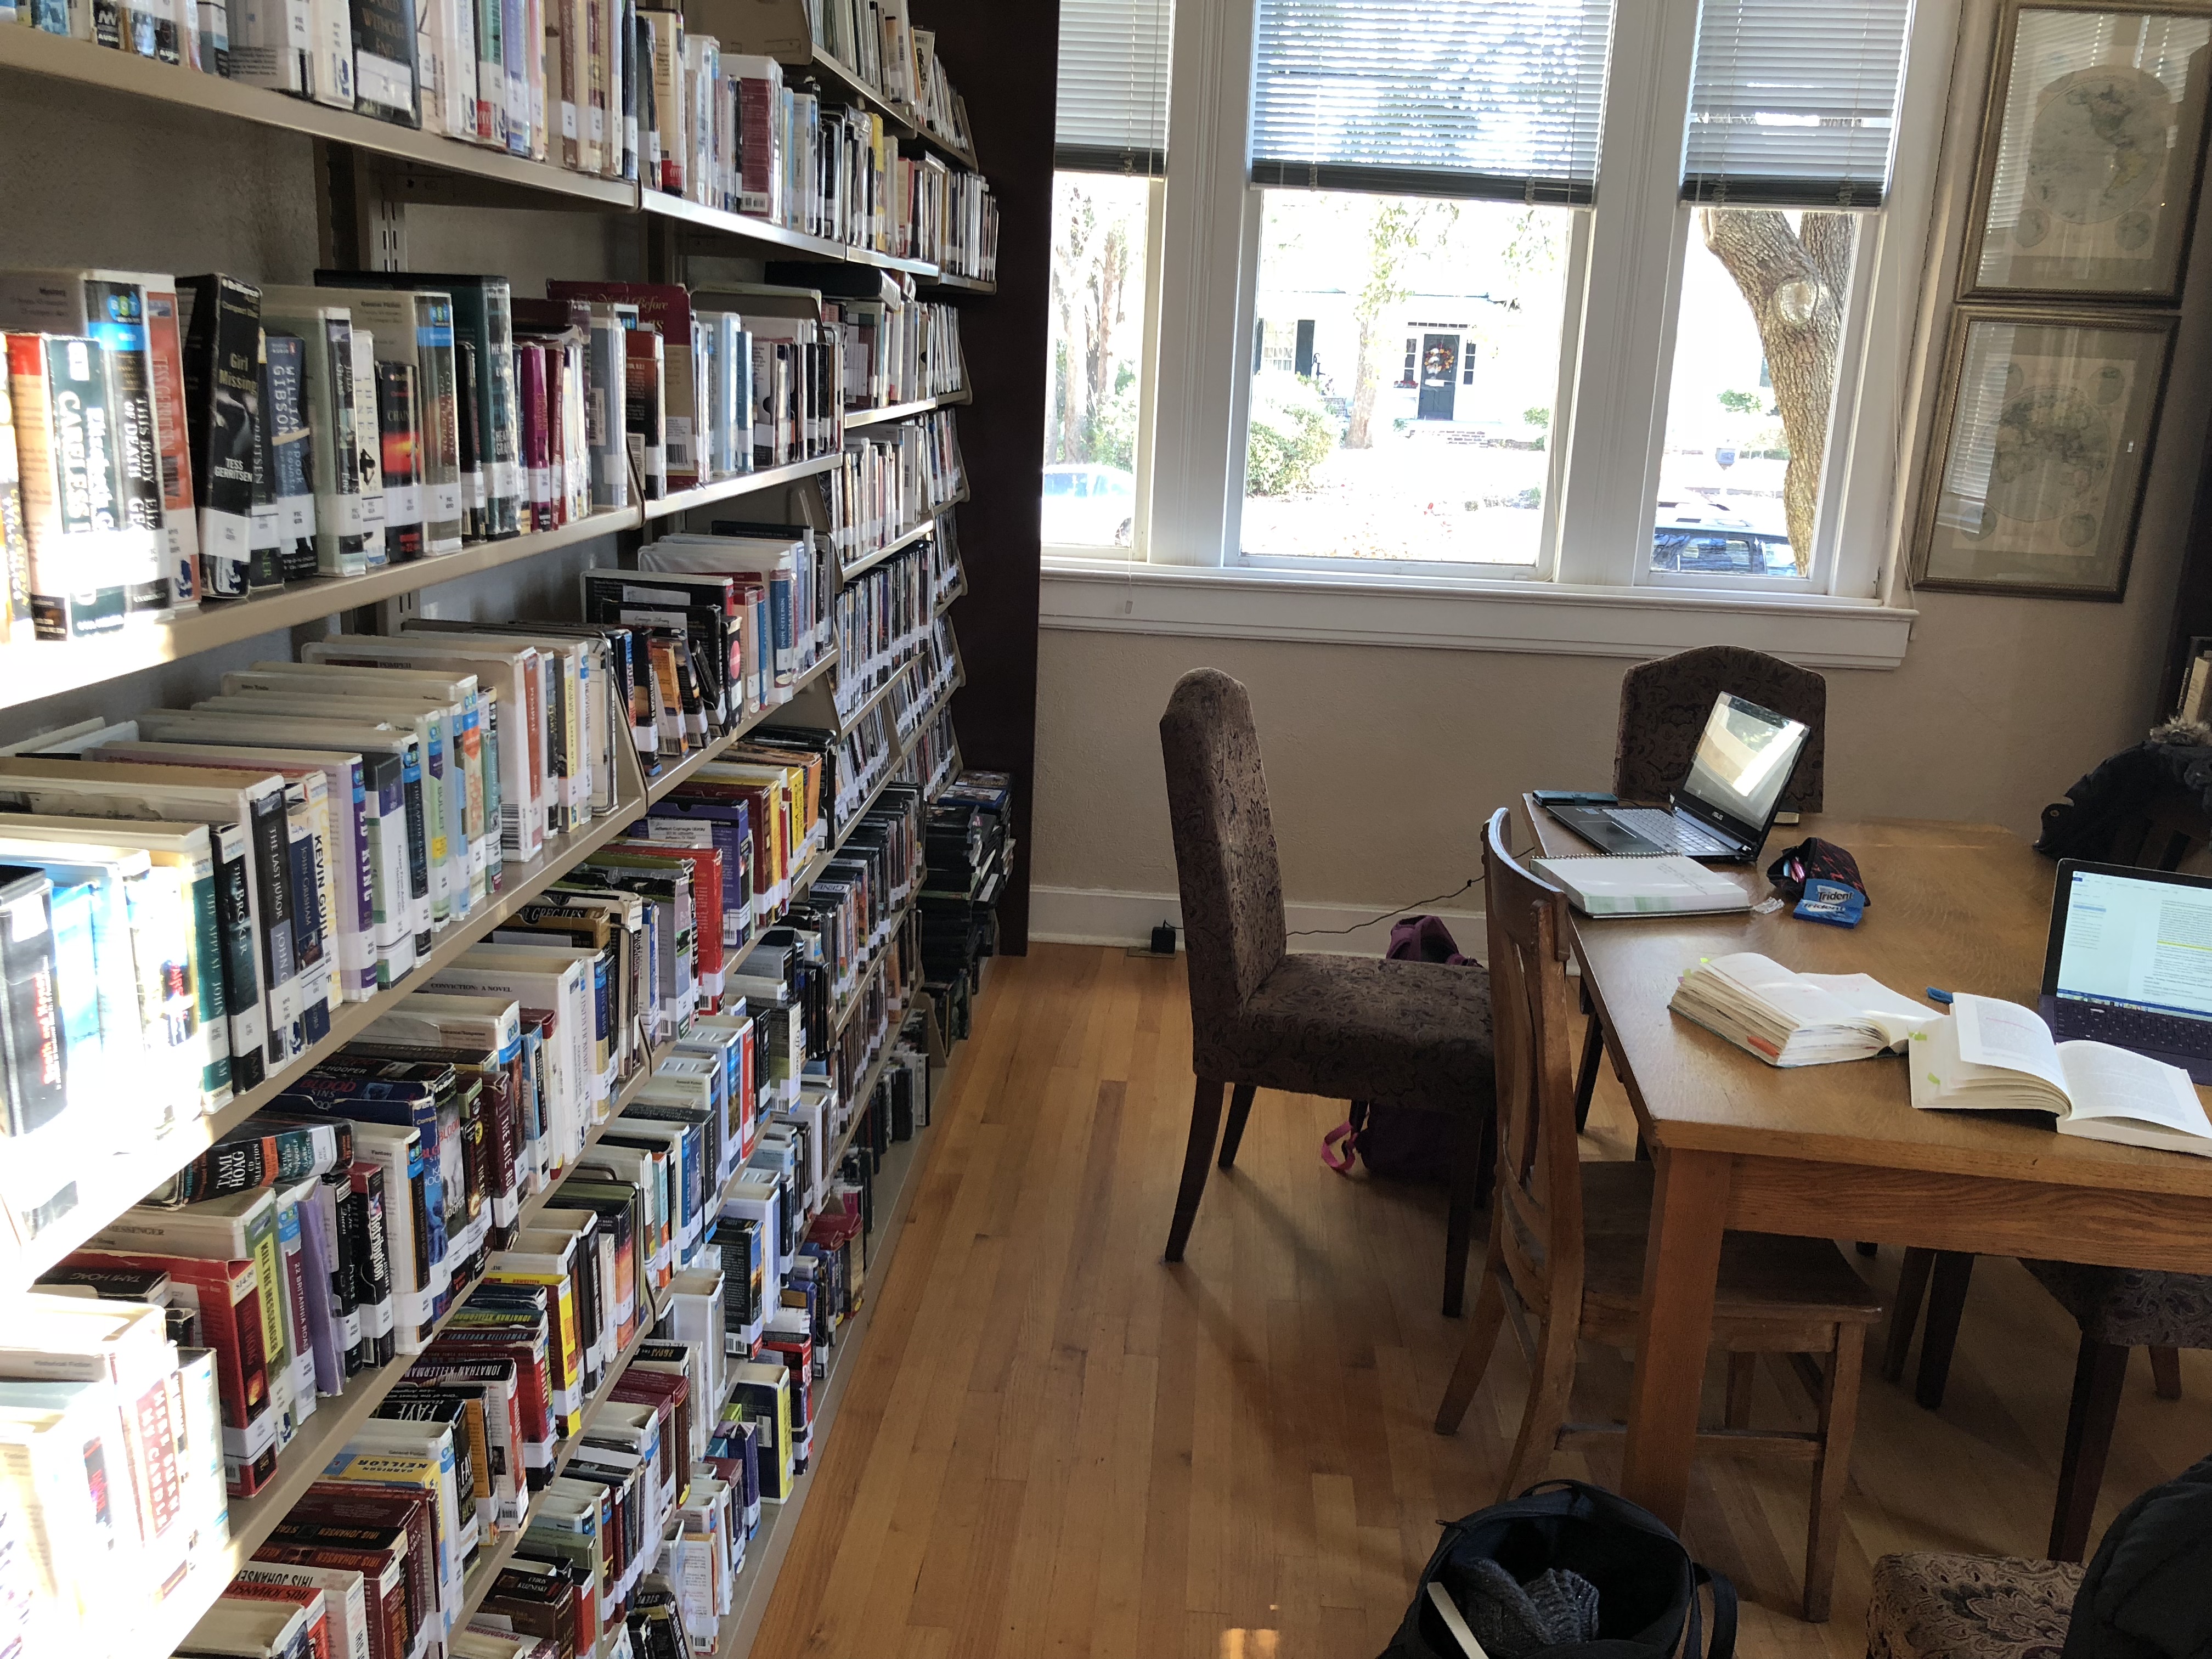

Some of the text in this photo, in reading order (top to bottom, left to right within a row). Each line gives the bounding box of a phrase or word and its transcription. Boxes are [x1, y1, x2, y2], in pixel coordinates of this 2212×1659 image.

[634, 295, 668, 313] Before
[230, 353, 248, 372] Girl
[219, 370, 257, 395] Missing
[153, 357, 175, 451] TESS GERRITSEN
[274, 366, 289, 436] GIBSON
[365, 377, 376, 445] THREE
[124, 423, 142, 478] DEATH
[140, 439, 154, 484] BODY
[215, 466, 252, 482] GERRITSEN
[225, 456, 244, 470] TESS
[294, 442, 305, 484] spook
[269, 826, 284, 920] THE LAST JUROR
[314, 835, 325, 889] KEVIN
[300, 845, 312, 926] JOHN GRISHAM
[362, 848, 373, 901] KING
[1803, 902, 1846, 912] Trident
[1818, 890, 1853, 901] Trident
[234, 890, 248, 956] BROKER
[531, 907, 584, 921] GREG ILES
[275, 931, 288, 969] JOHN
[431, 983, 478, 991] CONVICTION:
[326, 1066, 368, 1075] HOOPER
[417, 1116, 436, 1125] Comp
[501, 1115, 511, 1141] THE
[504, 1141, 514, 1169] KITE
[216, 1154, 233, 1189] TAMI
[229, 1150, 246, 1187] HOAG
[444, 1197, 465, 1219] HOOPER
[110, 1225, 165, 1236] ESSENGER
[370, 1211, 385, 1281] Retribution
[110, 1274, 142, 1283] TAMI
[295, 1262, 301, 1274] 22
[261, 1242, 279, 1354] KILL THE MESSENGER
[296, 1275, 307, 1324] BRITANNIA
[405, 1365, 502, 1378] JONATHAN KELLERMAN
[397, 1403, 438, 1421] FAYE
[358, 1459, 428, 1469] KEILLOR
[235, 1569, 313, 1588] IRIS JOHANSE
[285, 1589, 311, 1601] IRIS
[355, 1629, 364, 1653] IRIS
[465, 1626, 521, 1641] TRANSMISSIO
